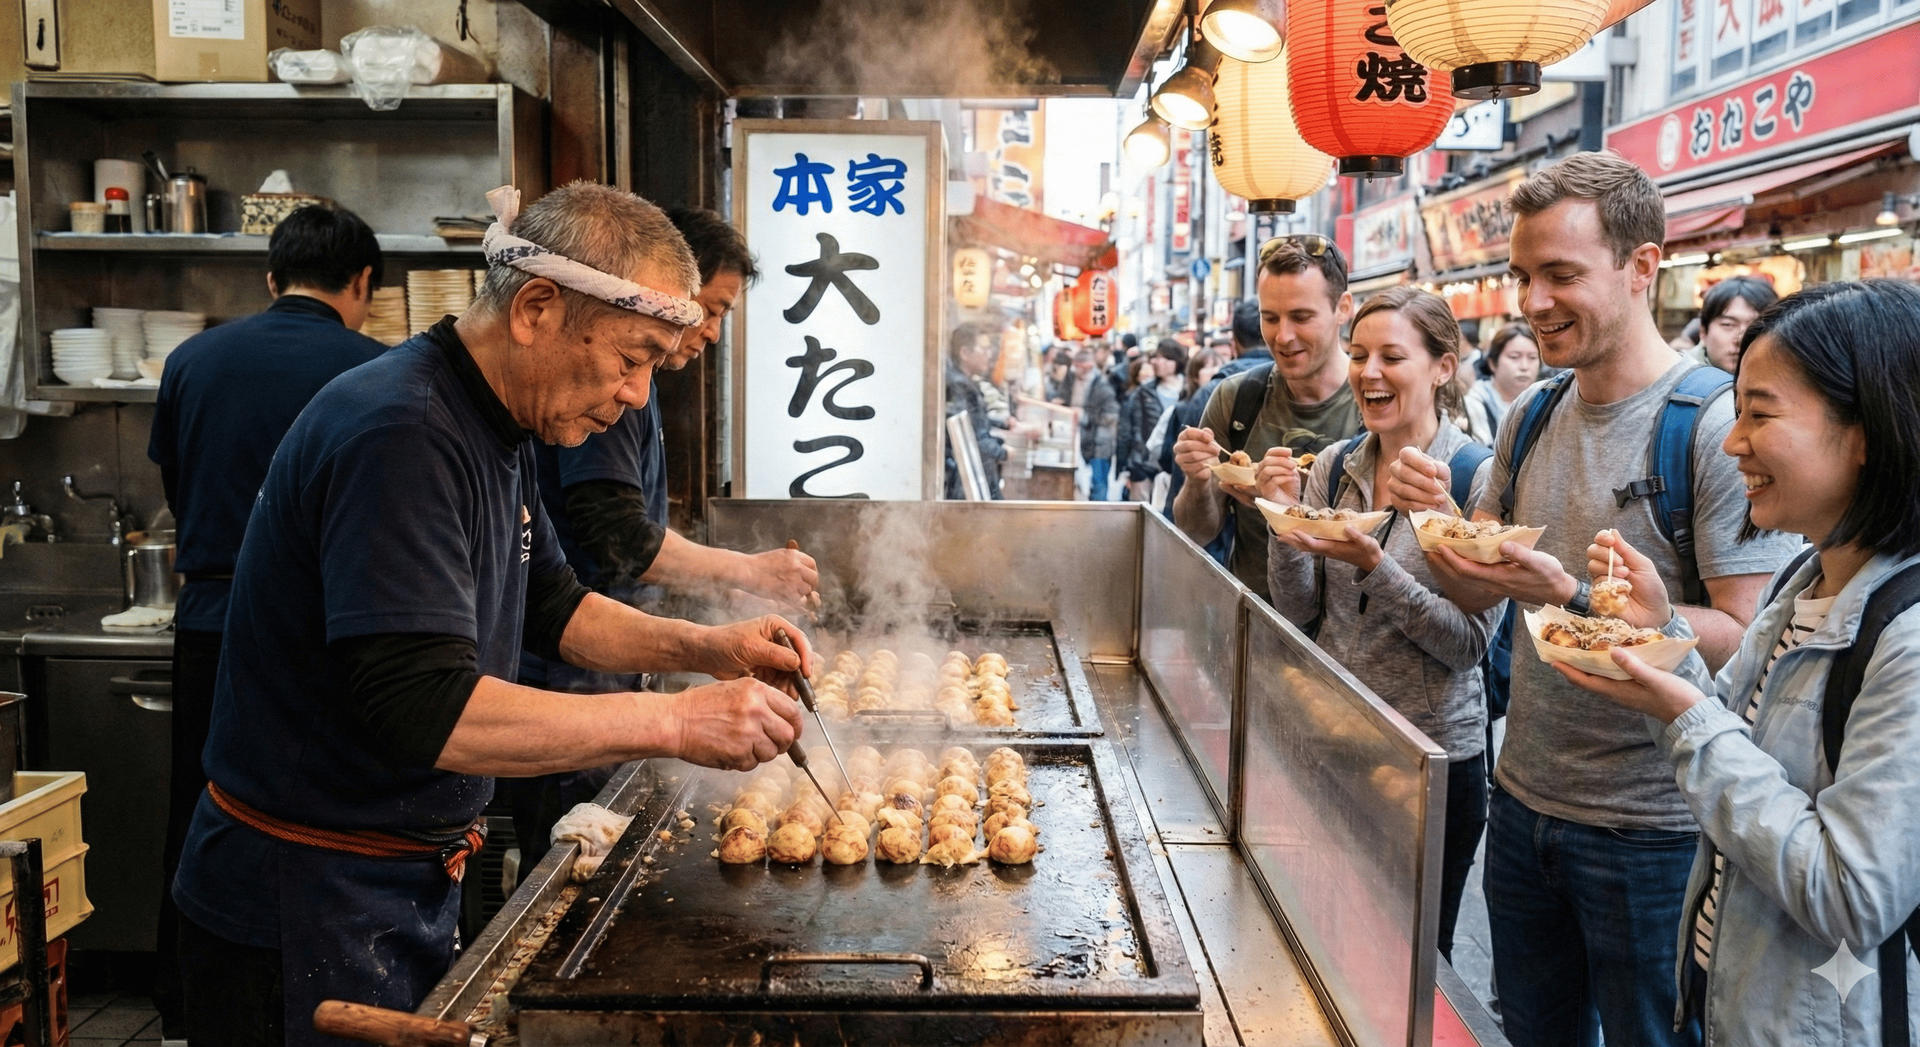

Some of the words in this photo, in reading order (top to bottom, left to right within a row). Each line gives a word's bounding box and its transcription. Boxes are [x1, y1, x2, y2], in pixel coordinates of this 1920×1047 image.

[772, 152, 908, 217] 本家
[782, 231, 881, 499] 大たこ
